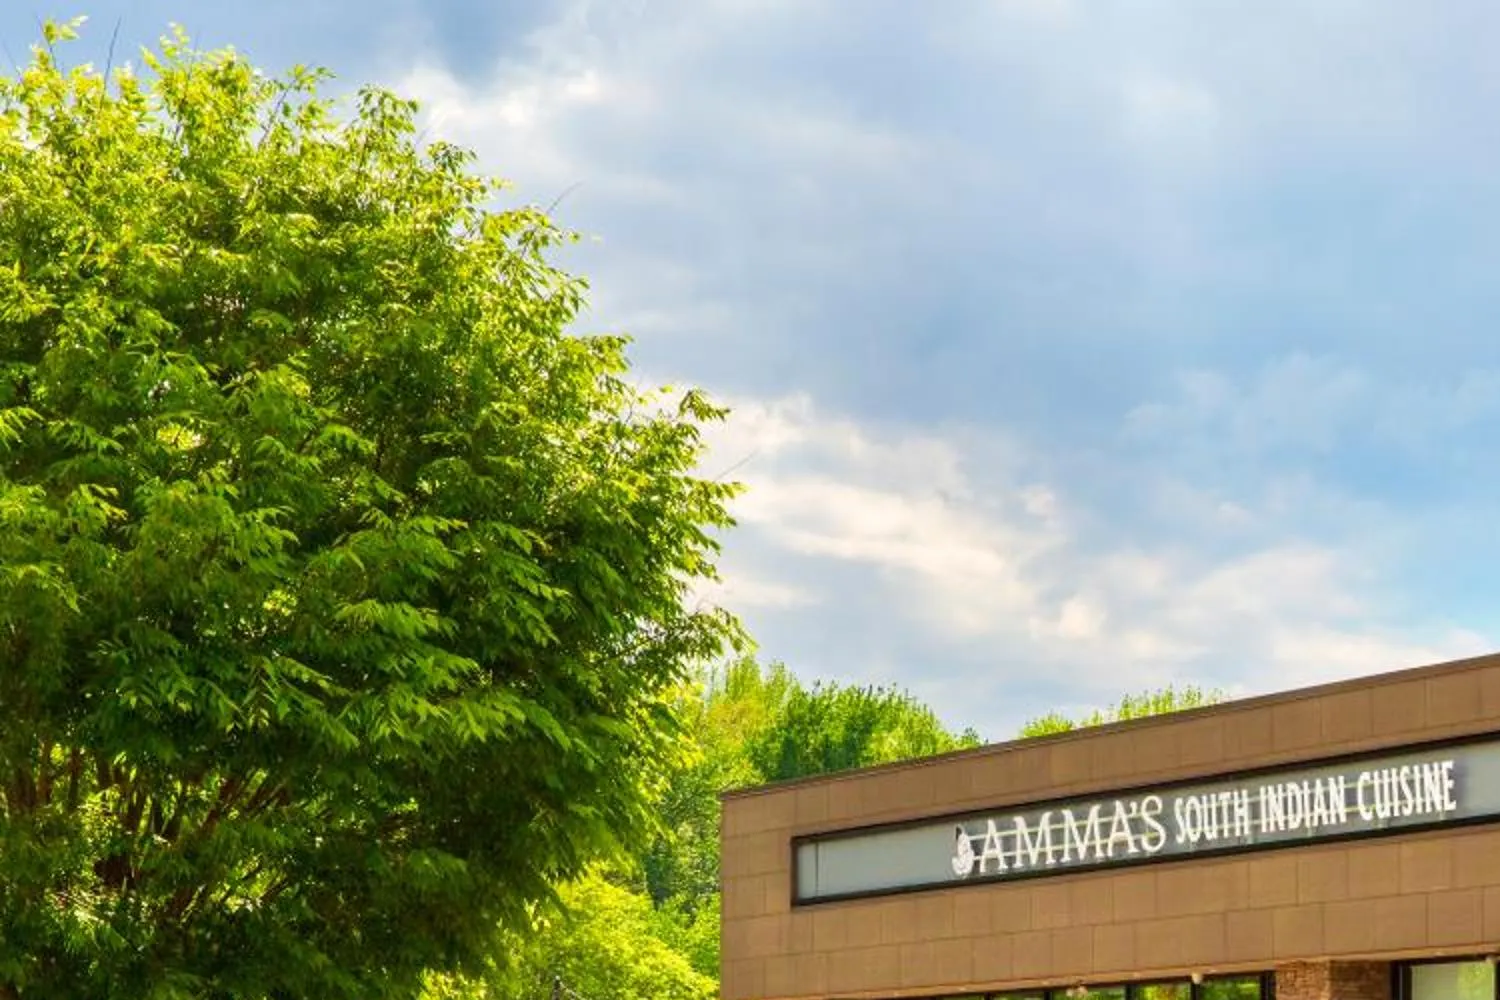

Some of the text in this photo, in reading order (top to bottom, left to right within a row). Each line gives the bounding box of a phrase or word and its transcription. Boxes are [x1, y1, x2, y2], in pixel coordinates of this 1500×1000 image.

[979, 760, 1457, 873] AMMA'S SOUTH INDIAN CUISINE
